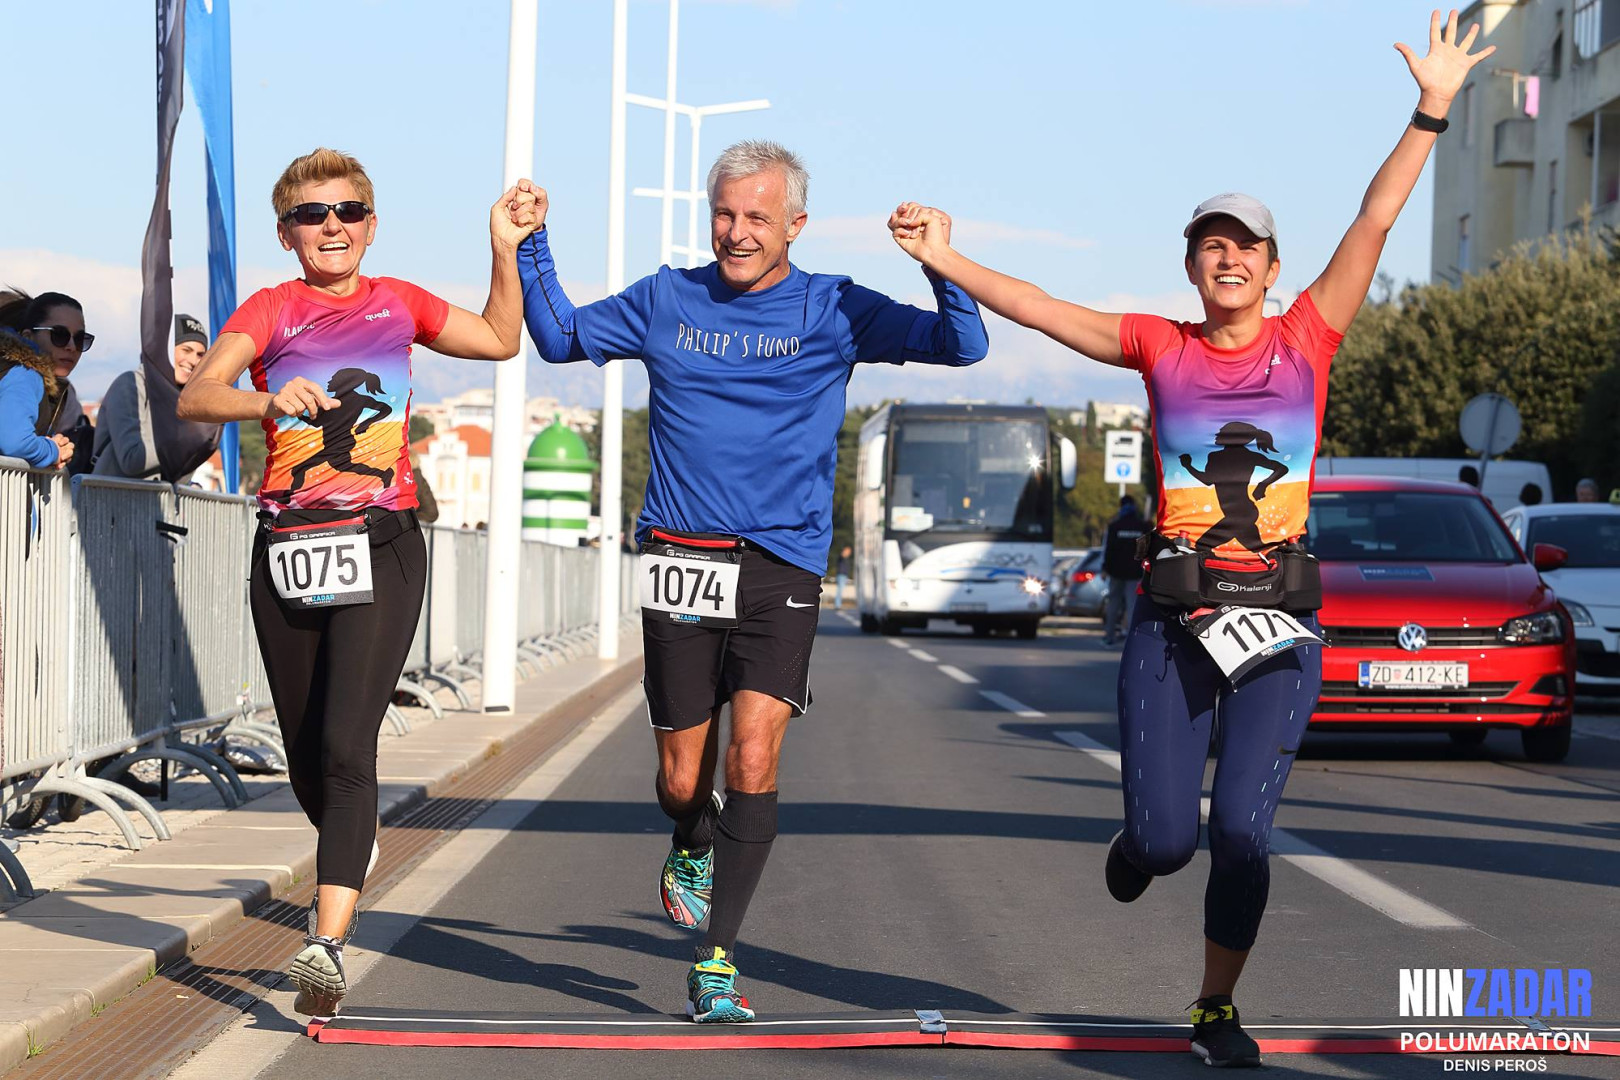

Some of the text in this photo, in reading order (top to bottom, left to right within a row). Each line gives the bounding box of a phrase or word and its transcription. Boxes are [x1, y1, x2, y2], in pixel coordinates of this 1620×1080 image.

[364, 308, 391, 322] quest
[675, 323, 800, 358] PHILIP'S FUND
[277, 544, 358, 591] 1075
[649, 563, 724, 611] 1074
[1239, 583, 1272, 592] Kalenji
[1222, 612, 1300, 653] 1171
[1372, 666, 1392, 683] ZD
